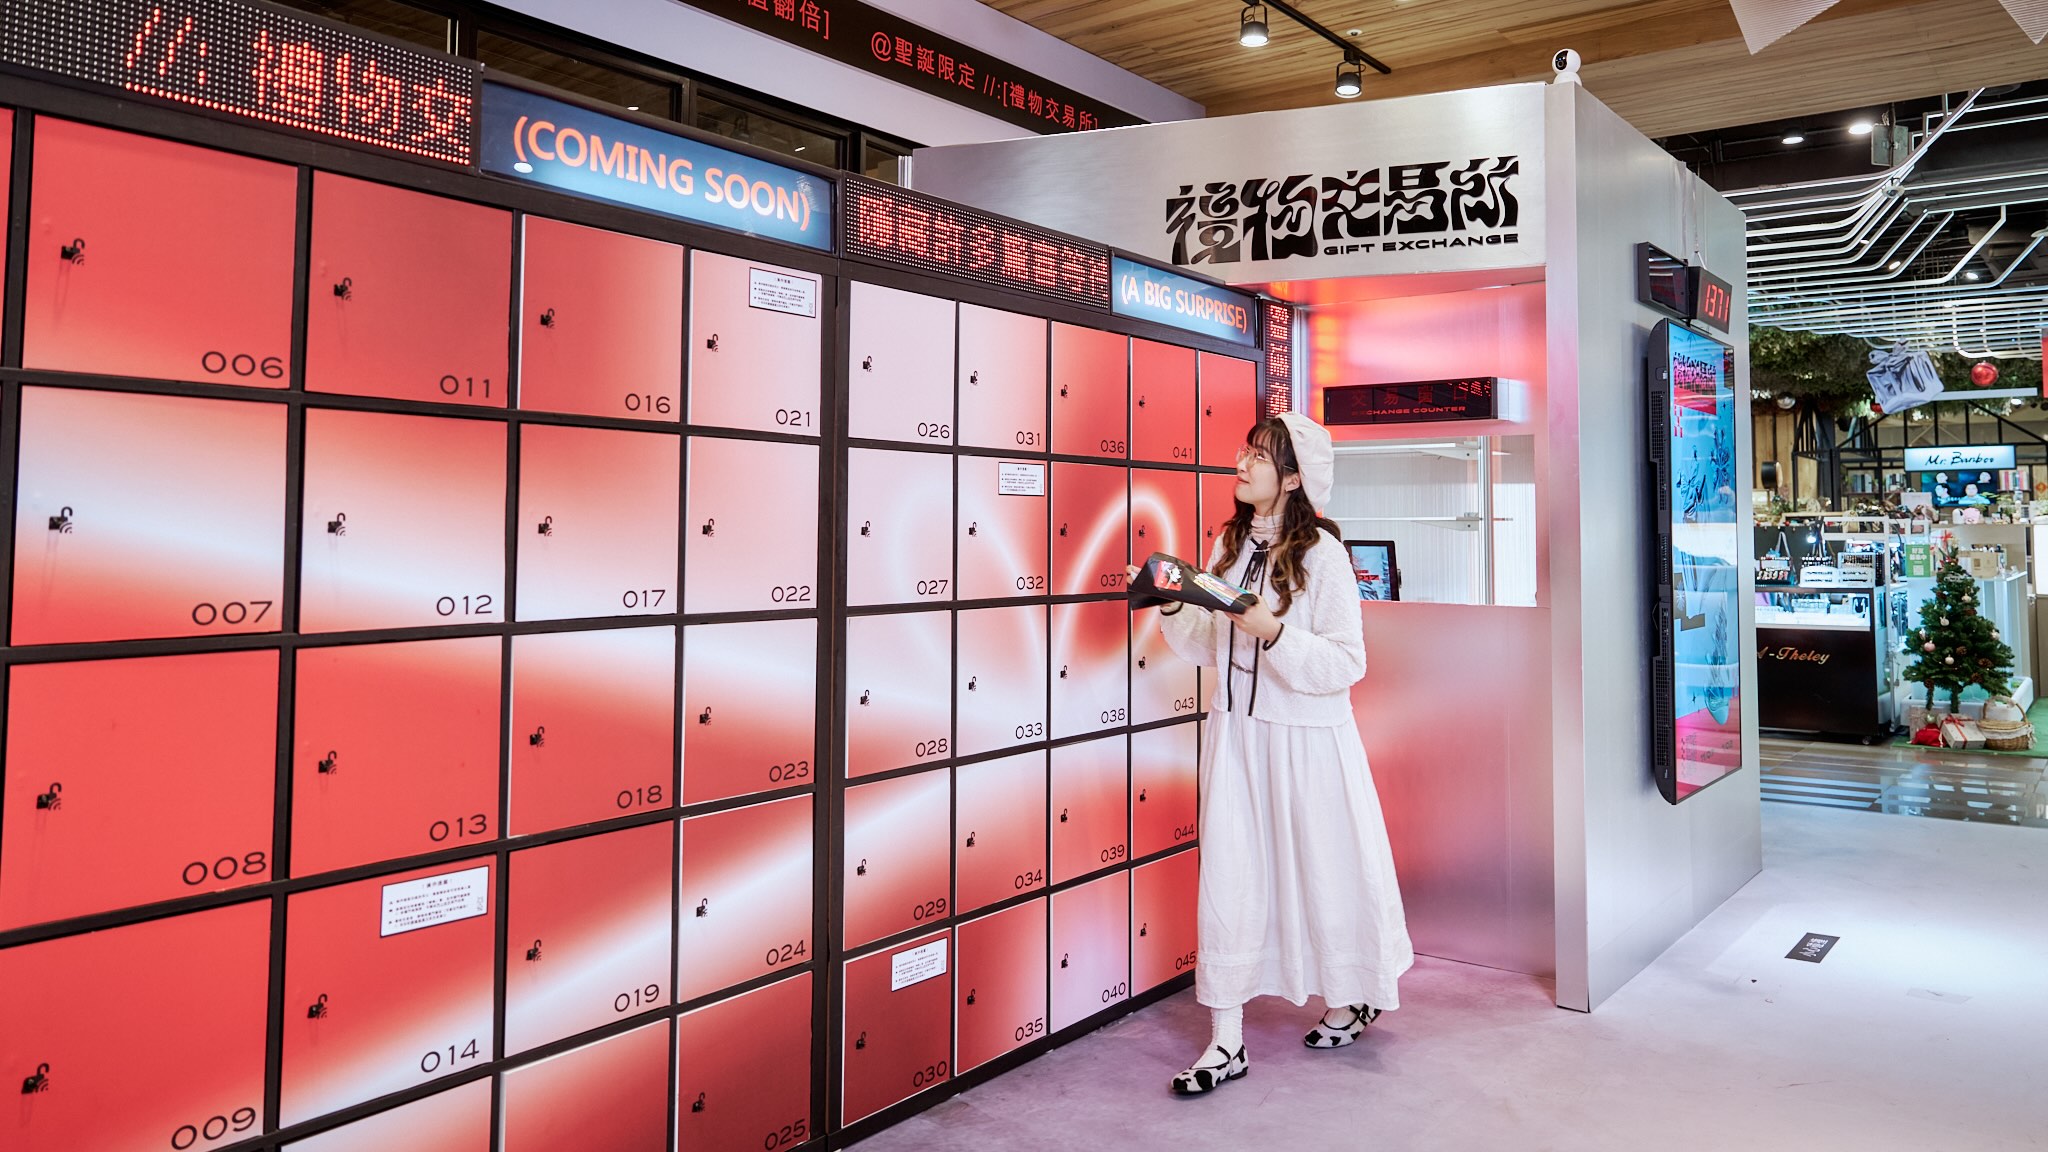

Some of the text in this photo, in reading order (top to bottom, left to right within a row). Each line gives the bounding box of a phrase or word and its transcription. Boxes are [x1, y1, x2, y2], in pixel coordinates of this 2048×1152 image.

[871, 31, 976, 90] @聖誕限定
[513, 116, 810, 231] (COMING SOON)
[1166, 155, 1519, 265] 禮物交易所
[1323, 233, 1519, 256] GIFT EXCHANGE
[1121, 275, 1247, 334] (A BIG SURPRISE)
[1705, 284, 1730, 322] 1371
[202, 351, 283, 379] 006
[440, 375, 492, 398] 011
[625, 393, 670, 414] 016
[776, 409, 810, 427] 021
[918, 422, 949, 439] 026
[1016, 431, 1040, 446] 031
[1101, 440, 1124, 453] 036
[1173, 447, 1193, 459] 041
[917, 580, 948, 595] 027
[1017, 576, 1043, 590] 032
[1101, 574, 1124, 587] 037
[623, 589, 666, 608] 017
[772, 583, 812, 603] 022
[192, 600, 272, 626] 007
[436, 595, 492, 616] 012
[1174, 697, 1194, 711] 043
[1101, 708, 1125, 724] 038
[1016, 722, 1042, 739] 033
[916, 738, 947, 757] 028
[769, 761, 808, 782] 023
[617, 786, 664, 809] 018
[429, 814, 488, 841] 013
[1175, 824, 1194, 840] 044
[1101, 844, 1124, 862] 039
[182, 852, 266, 885] 008
[1015, 869, 1042, 889] 034
[914, 898, 946, 920] 029
[766, 940, 806, 966] 024
[1176, 951, 1196, 970] 045
[614, 984, 659, 1012] 019
[1102, 982, 1126, 1003] 040
[1015, 1017, 1043, 1041] 035
[421, 1039, 479, 1073] 014
[913, 1061, 947, 1087] 030
[171, 1107, 256, 1150] 009
[765, 1119, 805, 1150] 025
